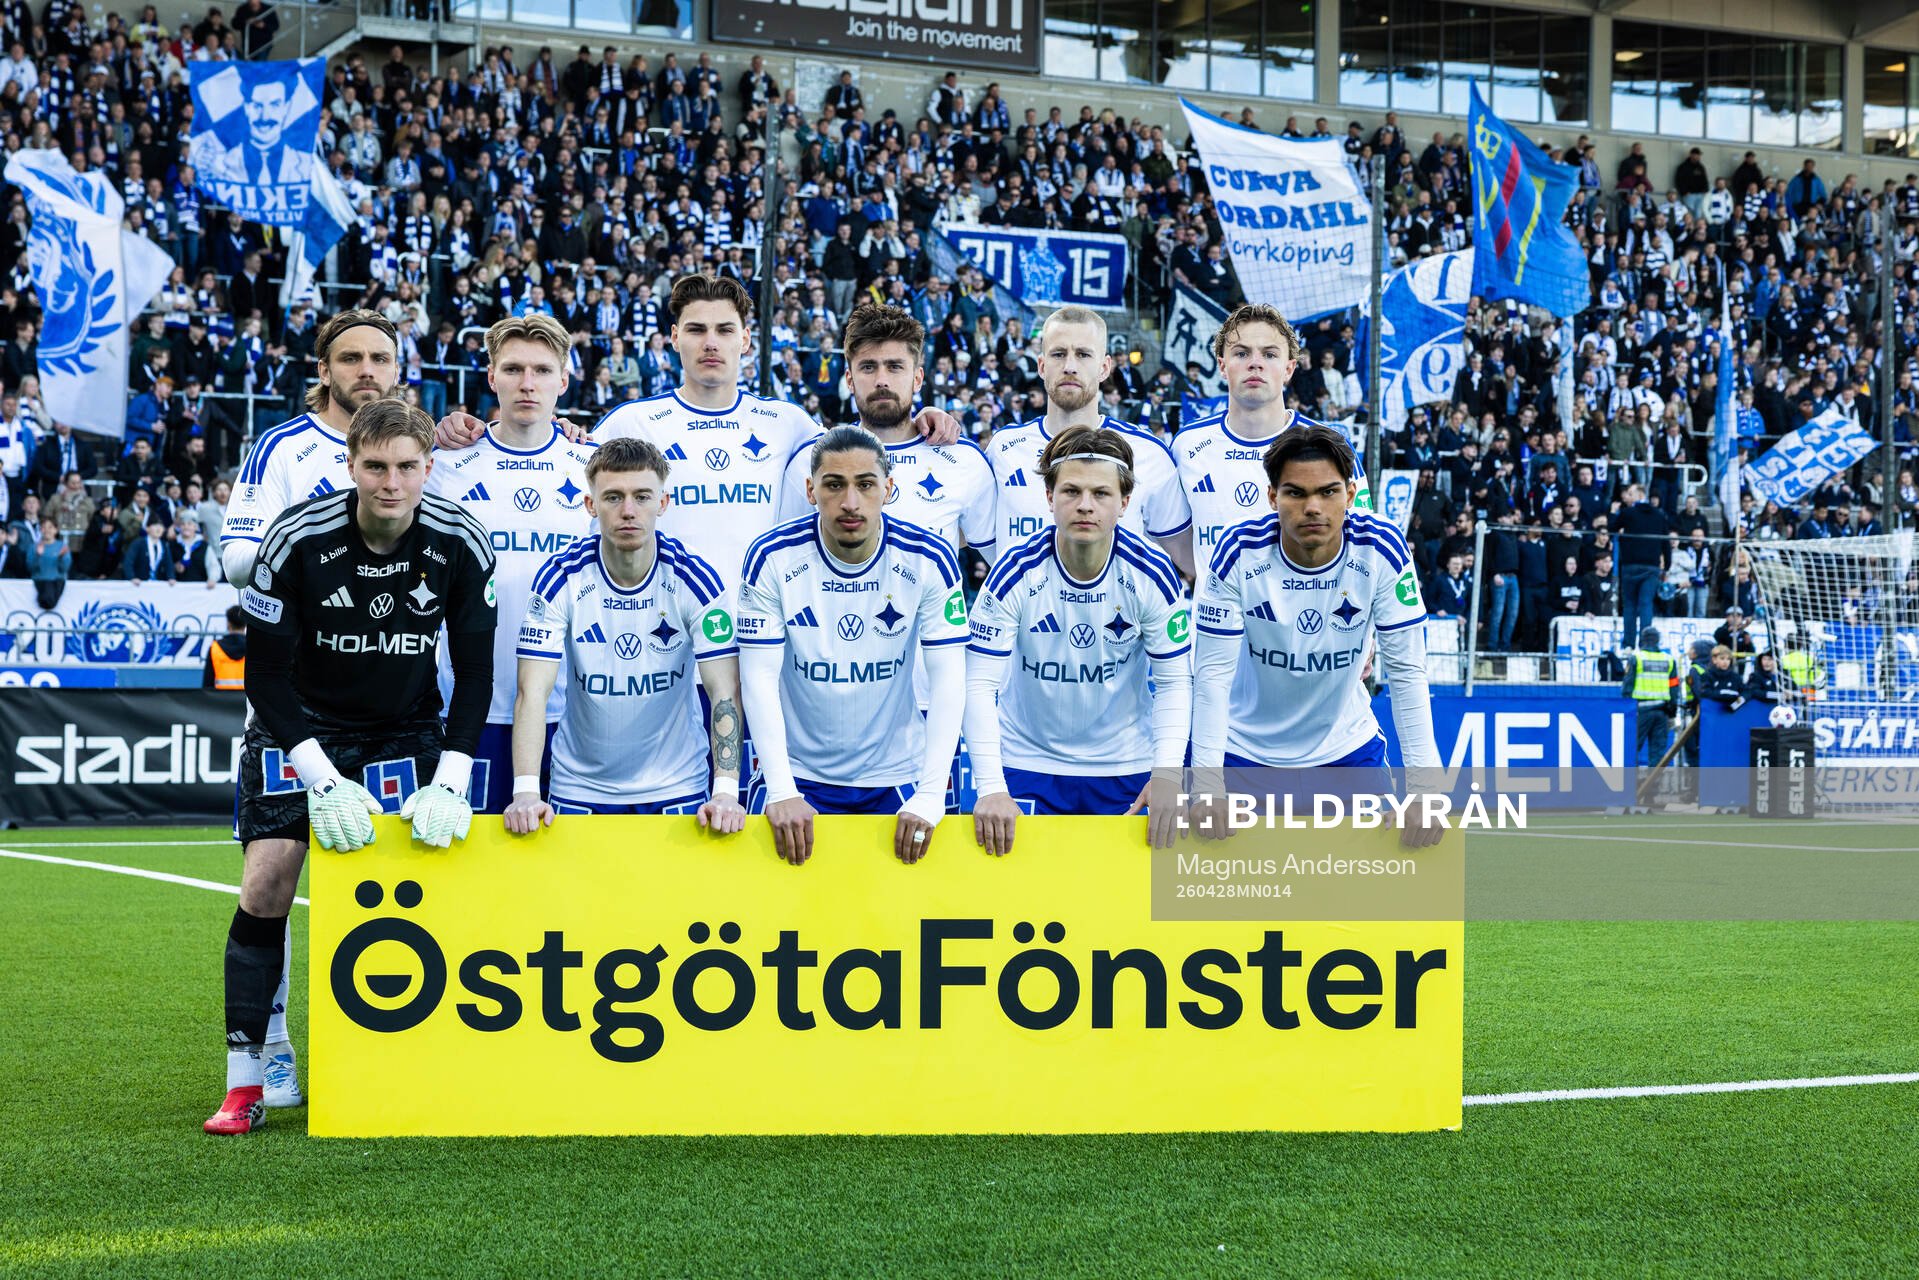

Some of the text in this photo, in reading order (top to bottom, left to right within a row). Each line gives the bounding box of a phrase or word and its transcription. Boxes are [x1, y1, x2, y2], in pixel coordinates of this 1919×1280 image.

[847, 16, 1022, 53] Join the movement
[1228, 234, 1354, 272] orrköping
[1068, 247, 1111, 298] 15
[654, 408, 672, 420] bilia
[760, 409, 778, 418] bilia
[687, 418, 740, 431] stadium
[302, 442, 318, 457] bilia
[1009, 436, 1026, 448] bilia
[1195, 438, 1212, 452] bilia
[462, 452, 480, 465] bilia
[496, 458, 554, 471] stadium
[576, 453, 588, 466] bili
[941, 451, 957, 464] bilia
[227, 517, 264, 528] UNIBET
[490, 531, 579, 553] OLME
[328, 546, 348, 560] bilia
[432, 552, 447, 565] bilia
[356, 561, 409, 578] stadium
[792, 563, 809, 578] bilia
[901, 569, 917, 584] bilia
[1253, 562, 1271, 577] bilia
[1355, 563, 1370, 577] bilia
[580, 583, 596, 596] bilia
[822, 579, 879, 593] stadium
[1282, 577, 1338, 591] stadium
[246, 590, 279, 613] UNIBET
[316, 629, 440, 655] HOLMEN
[1249, 638, 1364, 672] HOLMEN
[794, 650, 905, 683] HOLMEN
[575, 663, 685, 697] HOLMEN
[15, 723, 240, 785] stadiu
[1757, 748, 1769, 813] SELECT
[1789, 748, 1805, 814] SELECT
[330, 880, 1447, 1063] ÖstgötaFönster
